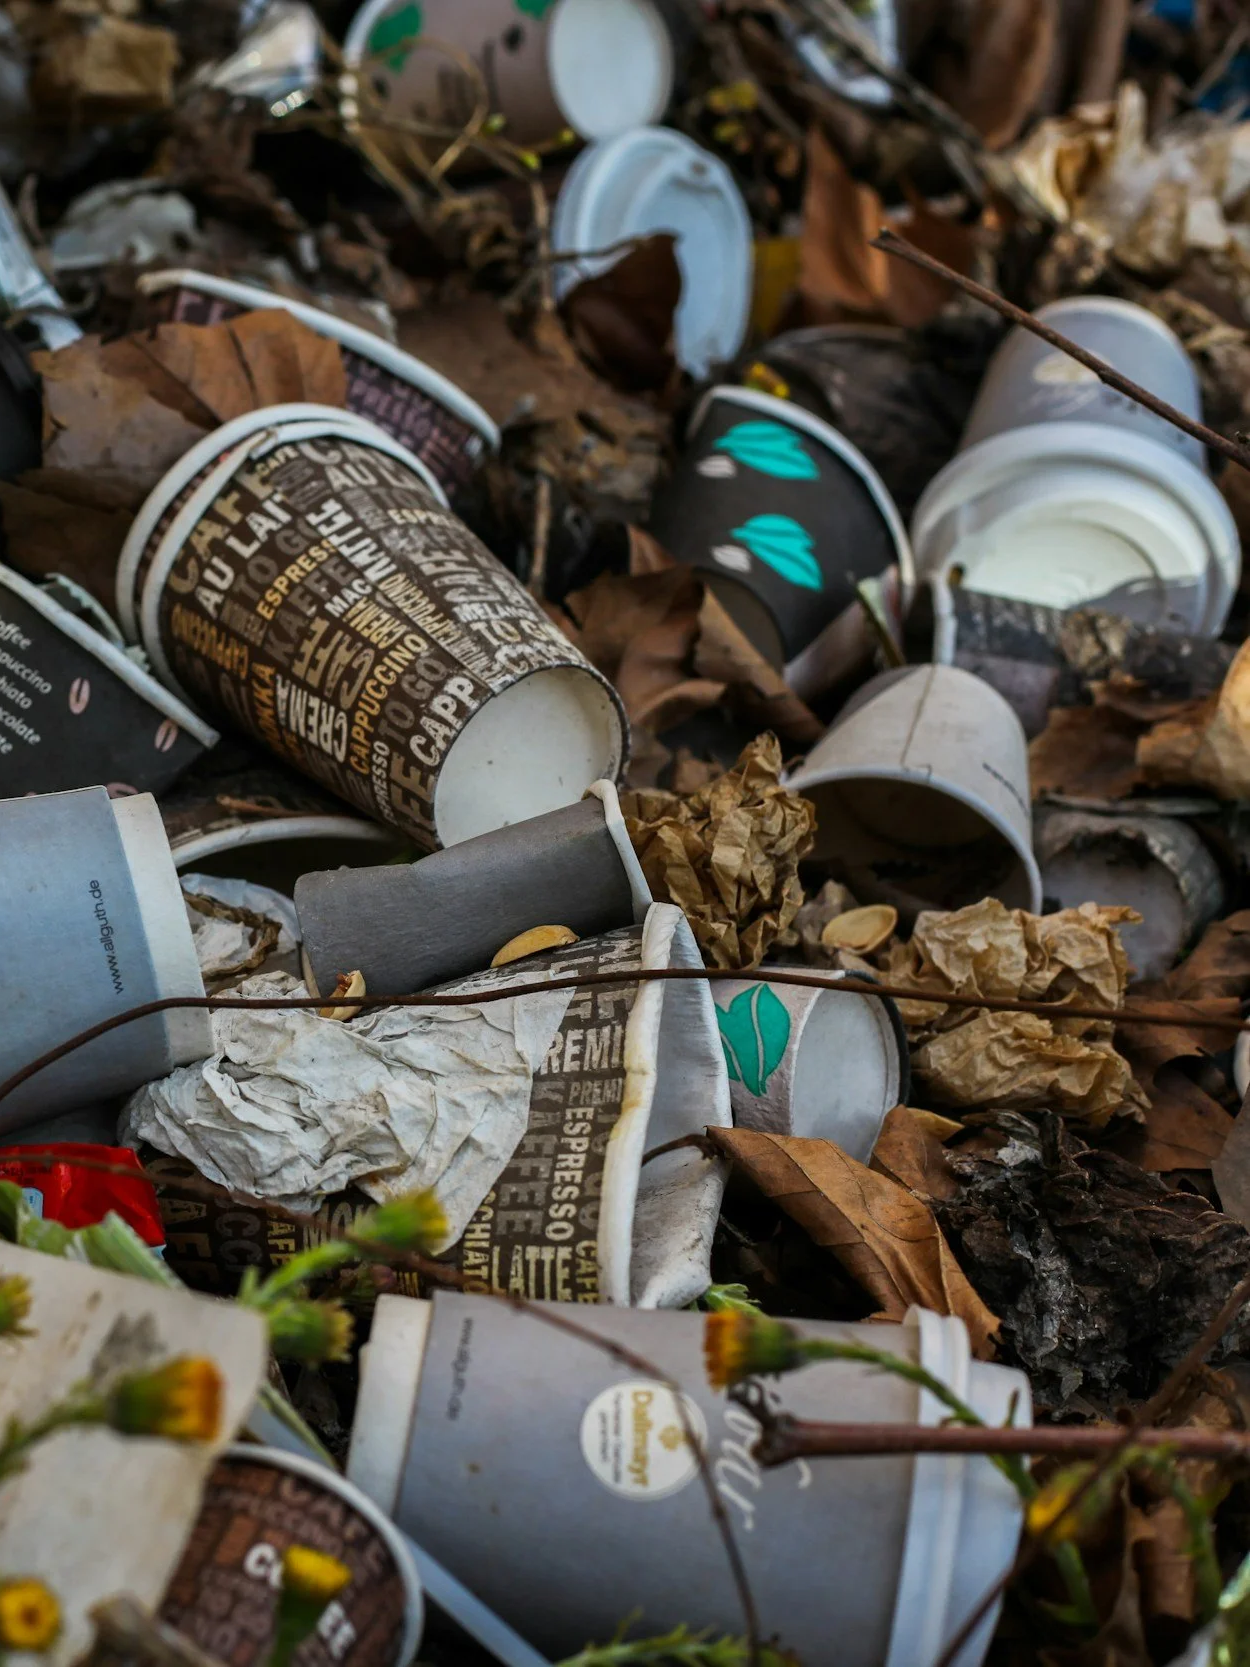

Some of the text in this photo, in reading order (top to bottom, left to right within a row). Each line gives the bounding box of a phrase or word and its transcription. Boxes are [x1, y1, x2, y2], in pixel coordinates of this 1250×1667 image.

[195, 555, 235, 619] AU
[324, 578, 372, 618] MAC
[343, 596, 401, 650] CREMA
[290, 616, 375, 710] CAFE
[350, 634, 429, 776] CAPPUCCINO
[378, 652, 448, 746] TO GO
[275, 673, 348, 764] CREMA
[88, 879, 125, 995] www.allguth.de
[545, 1106, 595, 1242] ESPRESSO
[491, 1244, 574, 1301] LATTE
